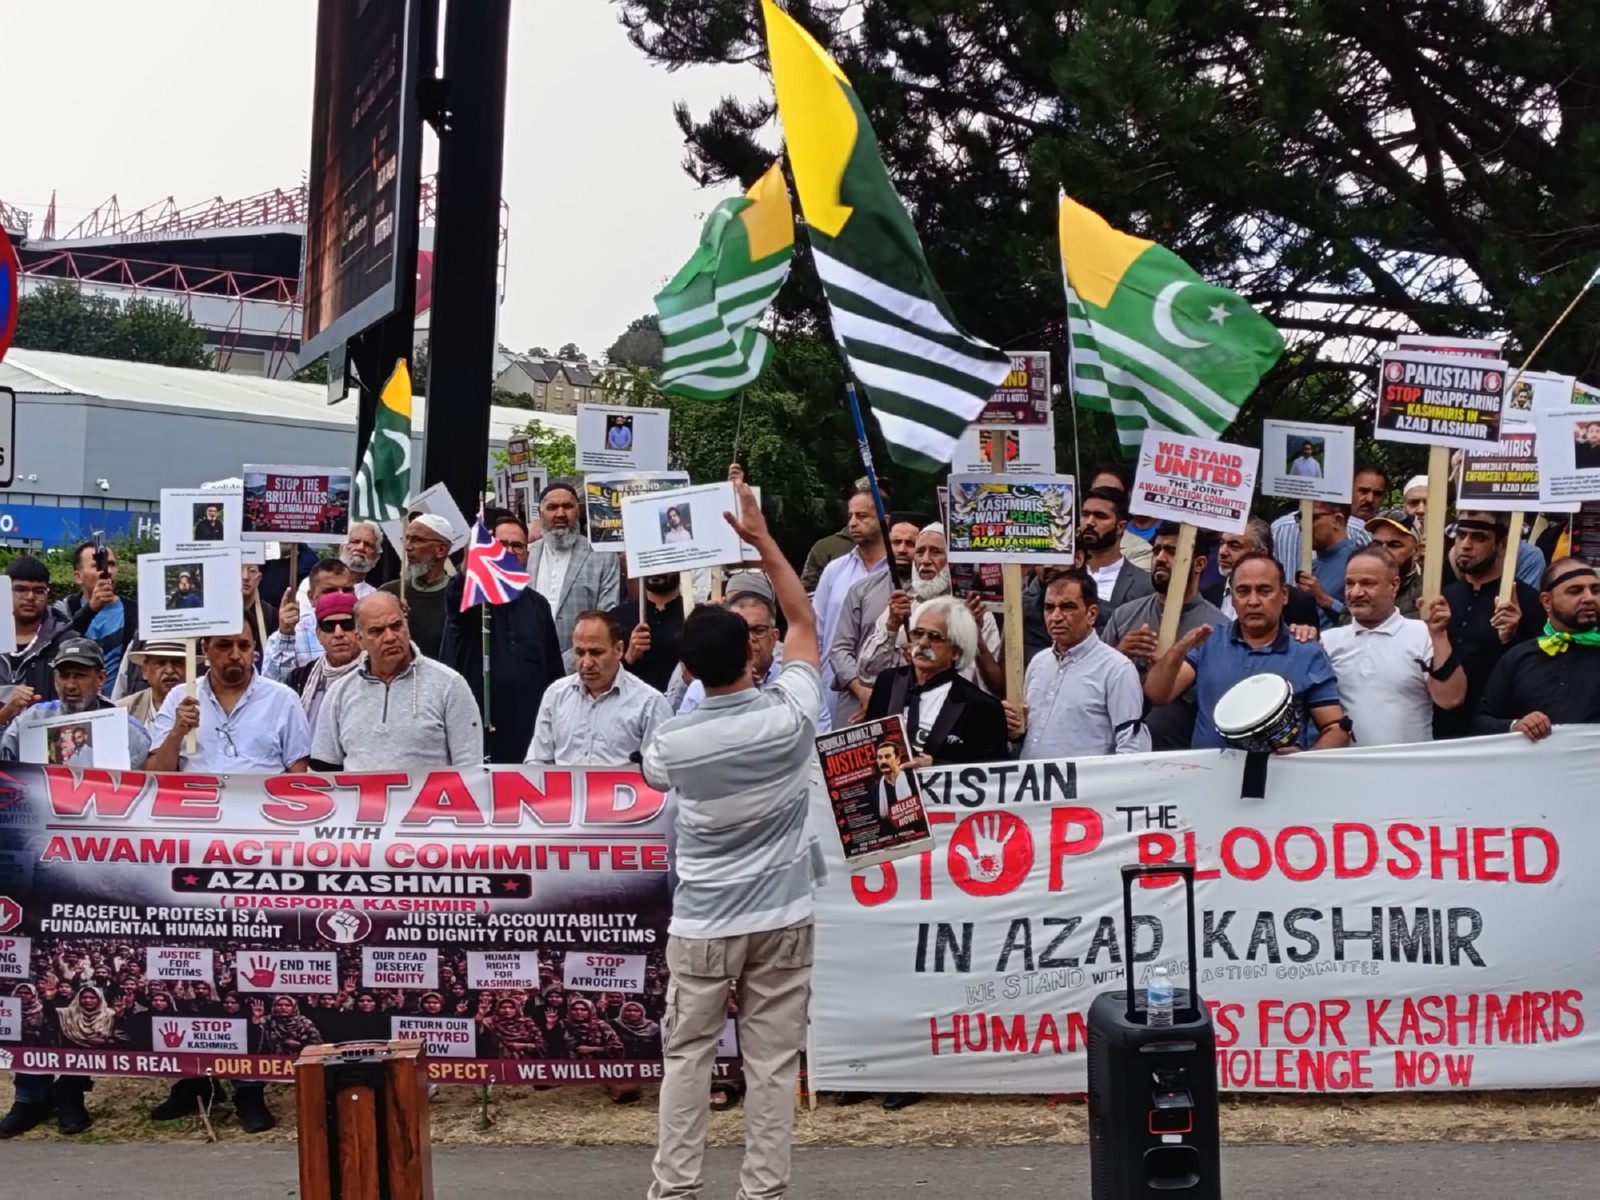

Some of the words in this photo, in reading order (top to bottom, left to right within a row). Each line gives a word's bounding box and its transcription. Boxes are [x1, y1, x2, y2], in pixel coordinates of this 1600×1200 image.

[1404, 363, 1484, 391] PAKISTAN
[1386, 385, 1422, 403] STOP
[1423, 388, 1500, 412] DISAPPEARING
[1406, 403, 1465, 421] KASHMIRIS
[1466, 410, 1479, 423] IN
[1395, 415, 1429, 432] AZAD
[1431, 420, 1489, 439] KASHMIR
[1158, 441, 1185, 455] WE
[1189, 447, 1243, 469] STAND
[1154, 454, 1243, 488] UNITED
[1471, 462, 1511, 471] IMMEDIATE
[1511, 462, 1539, 471] PRODUC
[1465, 471, 1506, 482] ENFORCEDLY
[275, 477, 299, 490] STOP
[302, 479, 320, 491] THE
[616, 484, 631, 492] WE
[631, 482, 660, 492] STAND
[1168, 479, 1189, 490] THE
[1192, 485, 1225, 496] JOINT
[1492, 483, 1500, 492] IN
[1501, 483, 1520, 492] AZAD
[1520, 483, 1540, 492] KASH
[265, 490, 328, 504] BRUTALITIES
[1138, 482, 1170, 495] AWAMI
[1171, 487, 1202, 501] ACTION
[1203, 495, 1248, 511] COMMITTEE
[268, 503, 277, 513] IN
[279, 503, 324, 514] RAWALAKOT
[977, 499, 1045, 513] KASHMIRIS
[1153, 494, 1185, 507] AZAD
[1187, 501, 1233, 517] KASHMIR
[974, 511, 1008, 523] WANT
[1009, 511, 1049, 524] PEACE
[972, 525, 1004, 537] STOP
[1004, 526, 1050, 537] KILLINGS
[971, 536, 1003, 548] AZAD
[846, 727, 871, 744] NAWAZ
[869, 722, 884, 736] MIR
[826, 743, 877, 778] JUSTICE!
[918, 762, 1078, 807] KISTAN
[43, 767, 221, 820] WE
[261, 771, 668, 826] STAND
[890, 796, 918, 815] RELEASE
[898, 812, 919, 828] NOW!
[1116, 805, 1177, 832] THE
[313, 826, 382, 840] WITH
[40, 835, 190, 864] AWAMI
[202, 839, 373, 868] ACTION
[384, 843, 671, 871] COMMITTEE
[1138, 822, 1560, 889] BLOODSHED
[207, 871, 306, 891] AZAD
[317, 874, 492, 894] KASHMIR
[234, 895, 355, 910] DIASPORA
[363, 898, 477, 912] KASHMIR
[52, 904, 141, 920] PEACEFUL
[147, 906, 227, 922] PROTEST
[231, 909, 249, 923] IS
[255, 910, 268, 923] A
[403, 912, 482, 927] JUSTICE,
[487, 913, 637, 928] ACCOUITABILITY
[41, 919, 161, 936] FUNDAMENTAL
[166, 922, 227, 937] HUMAN
[232, 924, 283, 938] RIGHT
[385, 927, 422, 941] AND
[427, 928, 499, 942] DIGNITY
[504, 929, 538, 942] FOR
[543, 929, 576, 943] ALL
[580, 929, 656, 943] VICTIMS
[915, 922, 974, 973] IN
[995, 914, 1164, 972] AZAD
[1203, 907, 1487, 967] KASHMIR
[158, 951, 201, 960] JUSTICE
[372, 951, 395, 960] OUR
[398, 951, 427, 961] DEAD
[484, 953, 521, 961] HUMAN
[586, 955, 626, 967] STOP
[169, 959, 190, 968] FOR
[279, 959, 305, 971] END
[307, 960, 332, 972] THE
[375, 961, 424, 972] DESERVE
[485, 962, 521, 970] RIGHTS
[158, 967, 202, 977] VICTIMS
[374, 972, 425, 984] DIGNITY
[494, 970, 513, 978] FOR
[593, 967, 617, 977] THE
[279, 974, 332, 985] SILENCE
[476, 979, 532, 987] KASHMIRIS
[571, 976, 637, 988] ATROCITIES
[965, 981, 996, 1006] WE
[1002, 967, 1085, 999] STAND
[1091, 967, 1125, 985] WITH
[1140, 960, 1190, 985] AAM
[1201, 963, 1268, 983] ACTION
[1275, 959, 1381, 980] COMMITTEE
[191, 1020, 233, 1032] STOP
[399, 1020, 443, 1030] RETURN
[446, 1021, 468, 1030] OUR
[930, 1012, 1088, 1055] HUMAN
[1257, 999, 1351, 1047] FOR
[1366, 989, 1584, 1047] KASHMIRIS
[193, 1032, 232, 1041] KILLING
[398, 1031, 470, 1043] MARTYRED
[187, 1042, 238, 1050] KASHMIRIS
[426, 1043, 450, 1054] OW
[23, 1051, 60, 1069] OUR
[65, 1053, 106, 1070] PAIN
[112, 1055, 130, 1071] IS
[136, 1056, 182, 1073] REAL
[214, 1057, 252, 1074] OUR
[259, 1059, 295, 1075] DEA
[1395, 1049, 1475, 1087] NOW
[428, 1063, 488, 1079] SPECT
[518, 1064, 548, 1080] WE
[551, 1064, 596, 1079] WILL
[600, 1064, 634, 1079] NOT
[640, 1063, 663, 1078] BE
